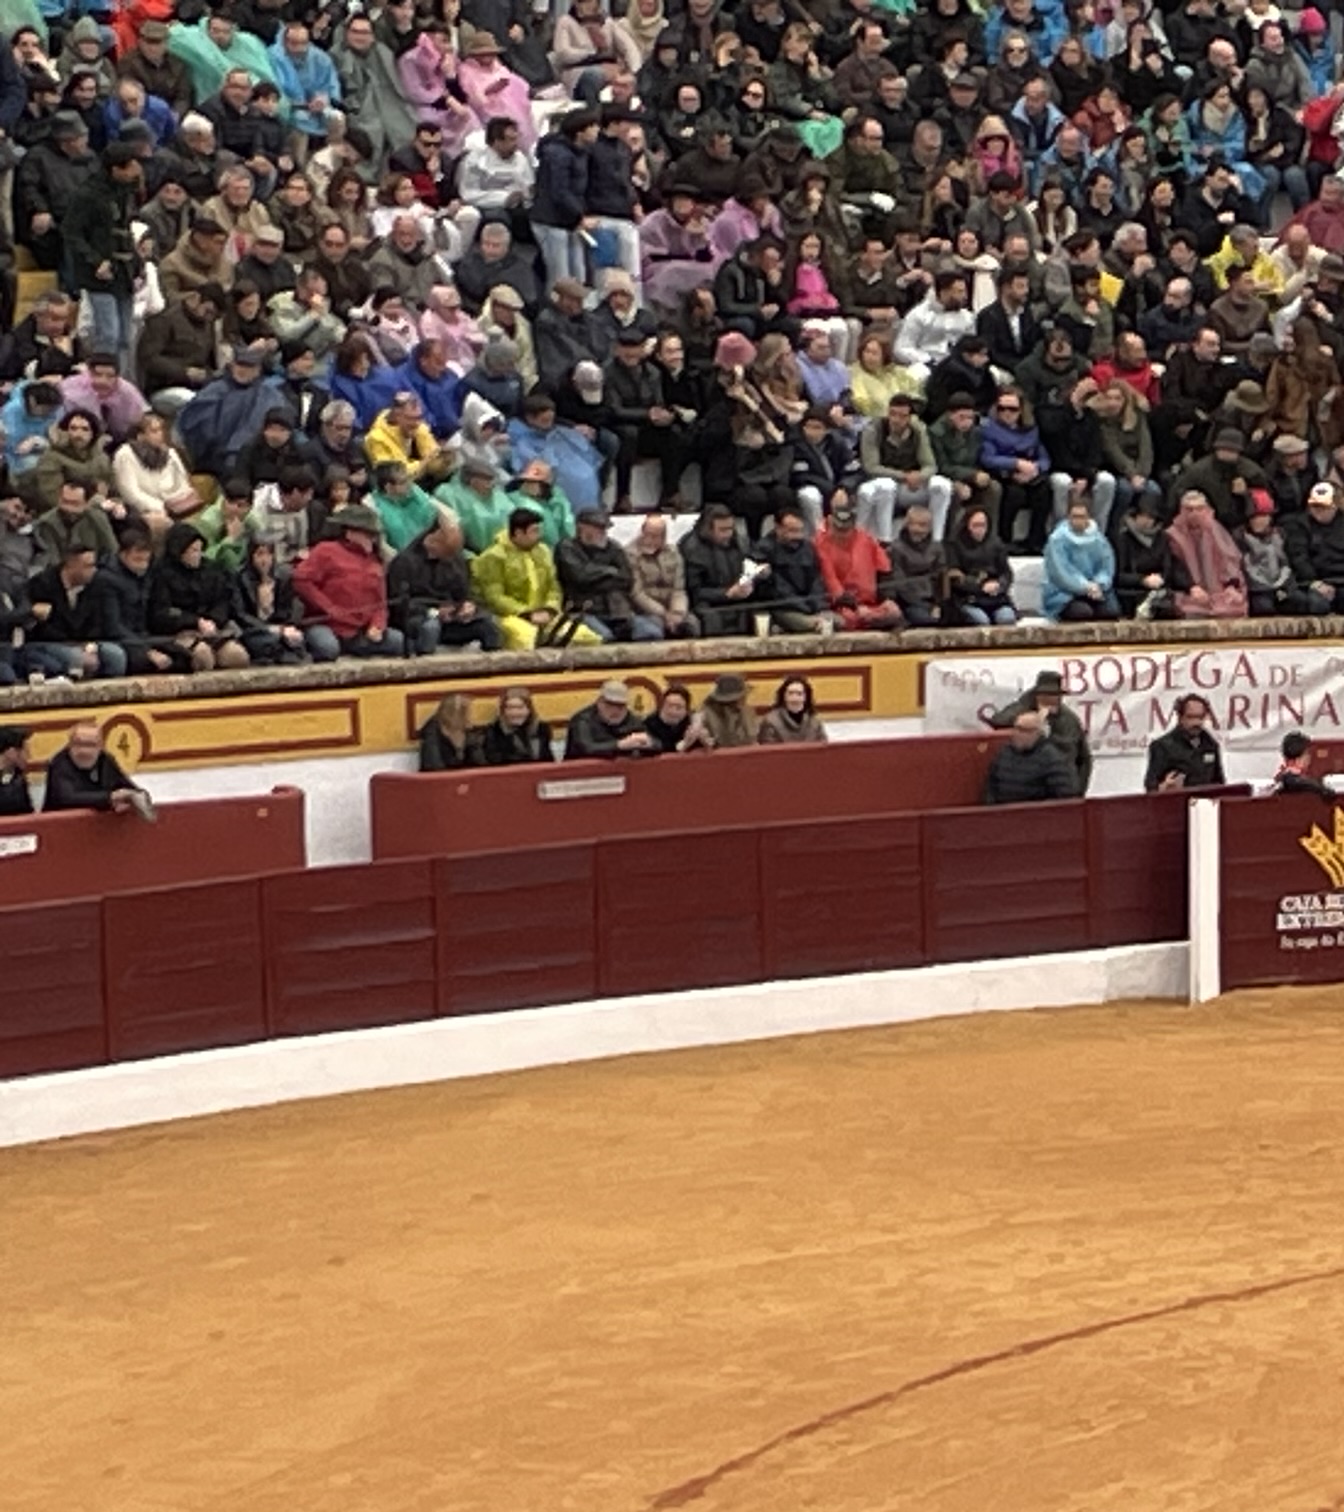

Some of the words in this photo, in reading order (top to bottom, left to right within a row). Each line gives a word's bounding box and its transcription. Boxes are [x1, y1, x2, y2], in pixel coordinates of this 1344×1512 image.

[1061, 649, 1258, 694] BODEGA
[1269, 664, 1303, 687] DE
[977, 700, 1130, 735] STA
[116, 731, 131, 757] 4
